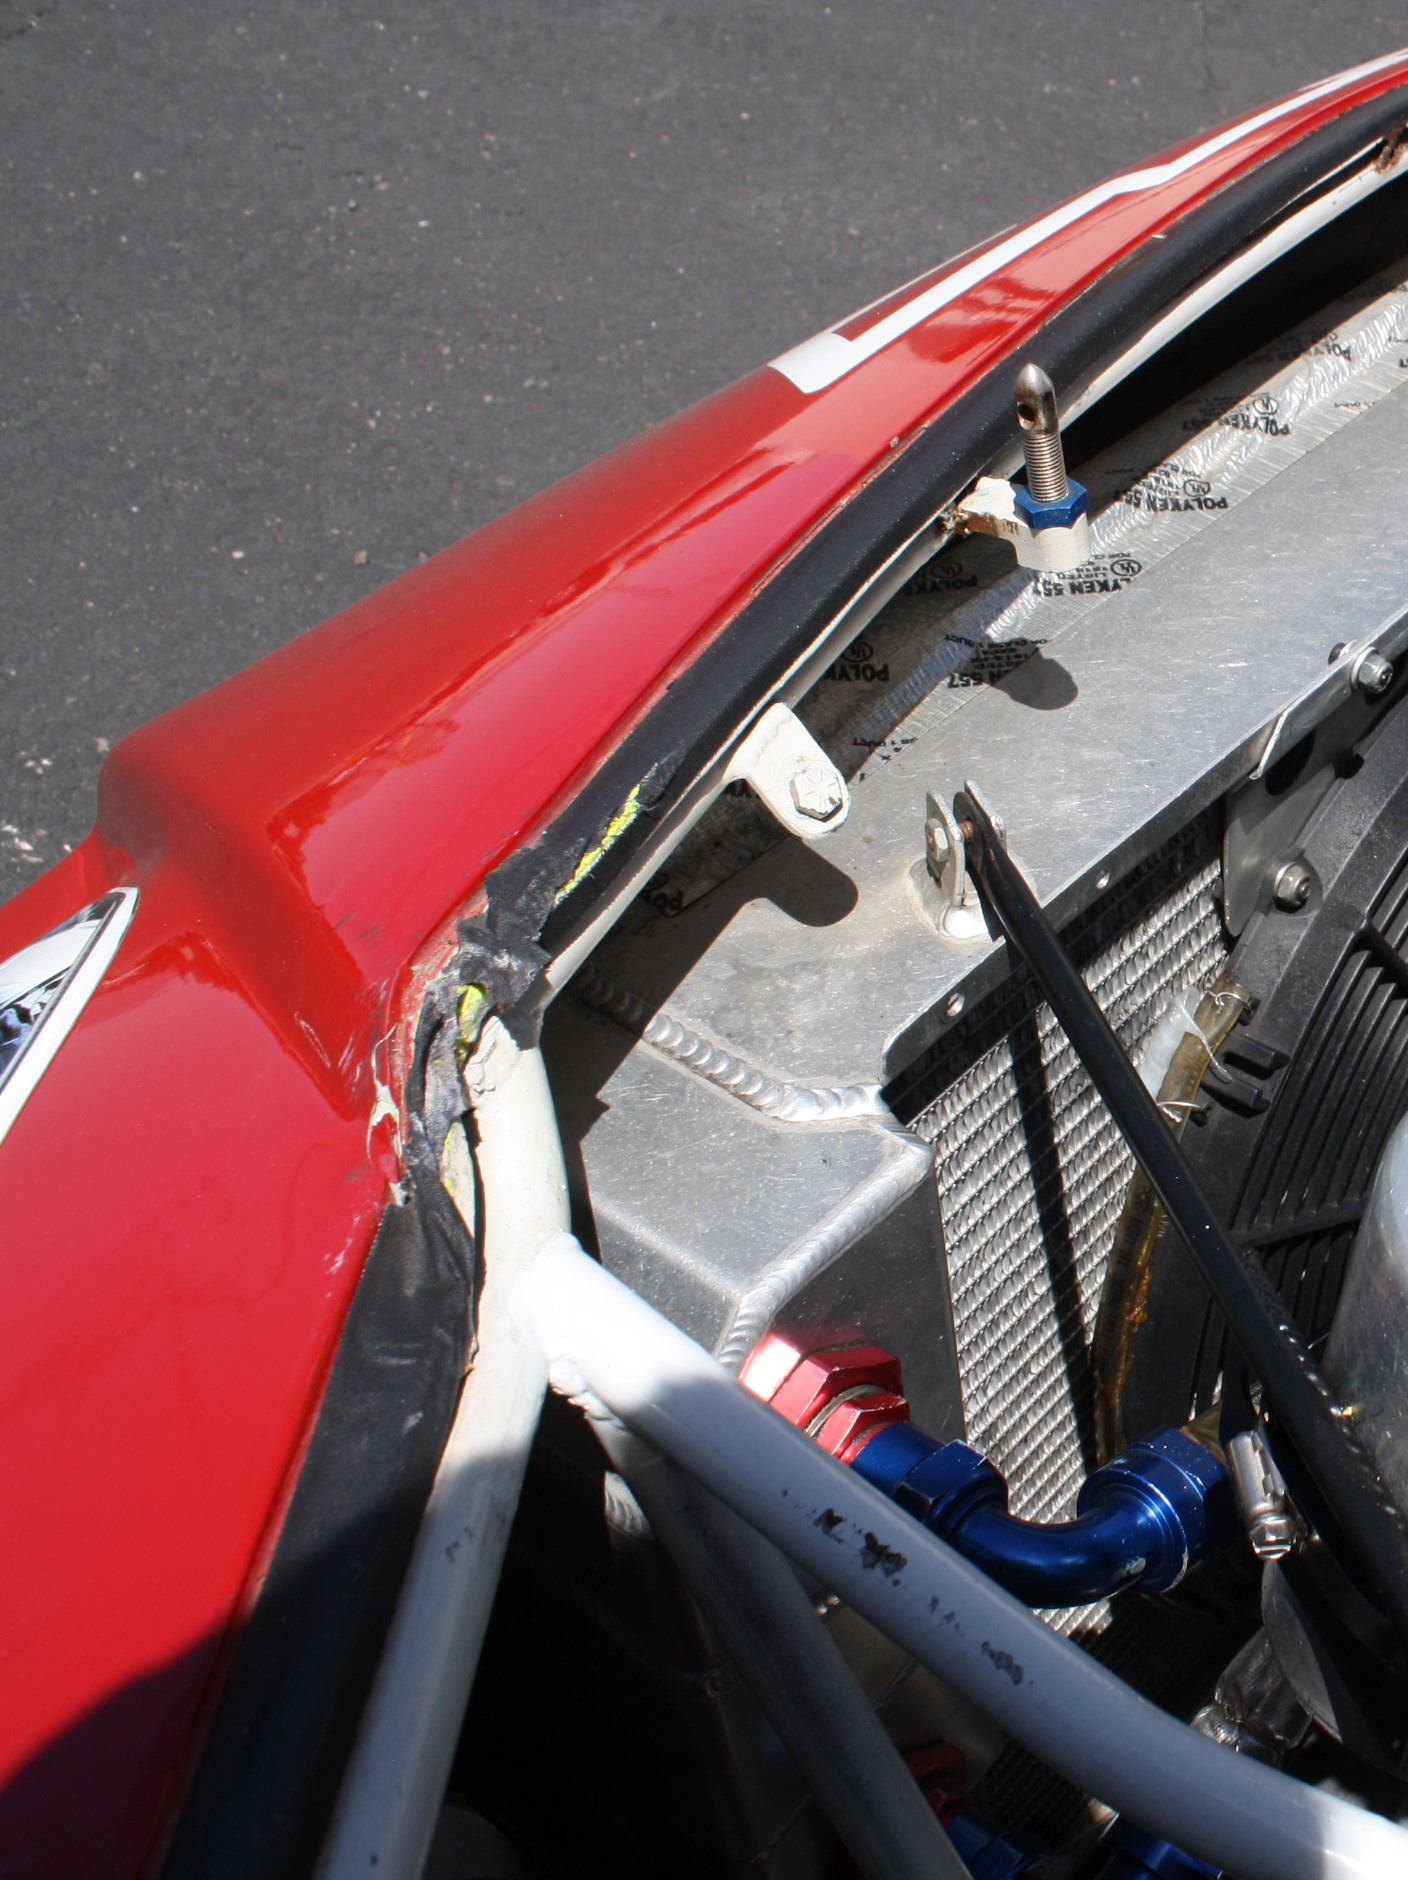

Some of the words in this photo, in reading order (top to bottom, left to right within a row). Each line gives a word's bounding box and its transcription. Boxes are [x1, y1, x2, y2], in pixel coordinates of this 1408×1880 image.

[1146, 492, 1229, 512] POLYKEN
[943, 634, 975, 648] DUCT
[947, 671, 985, 689] 557
[1117, 1249, 1132, 1267] IN
[1125, 1217, 1143, 1246] USA
